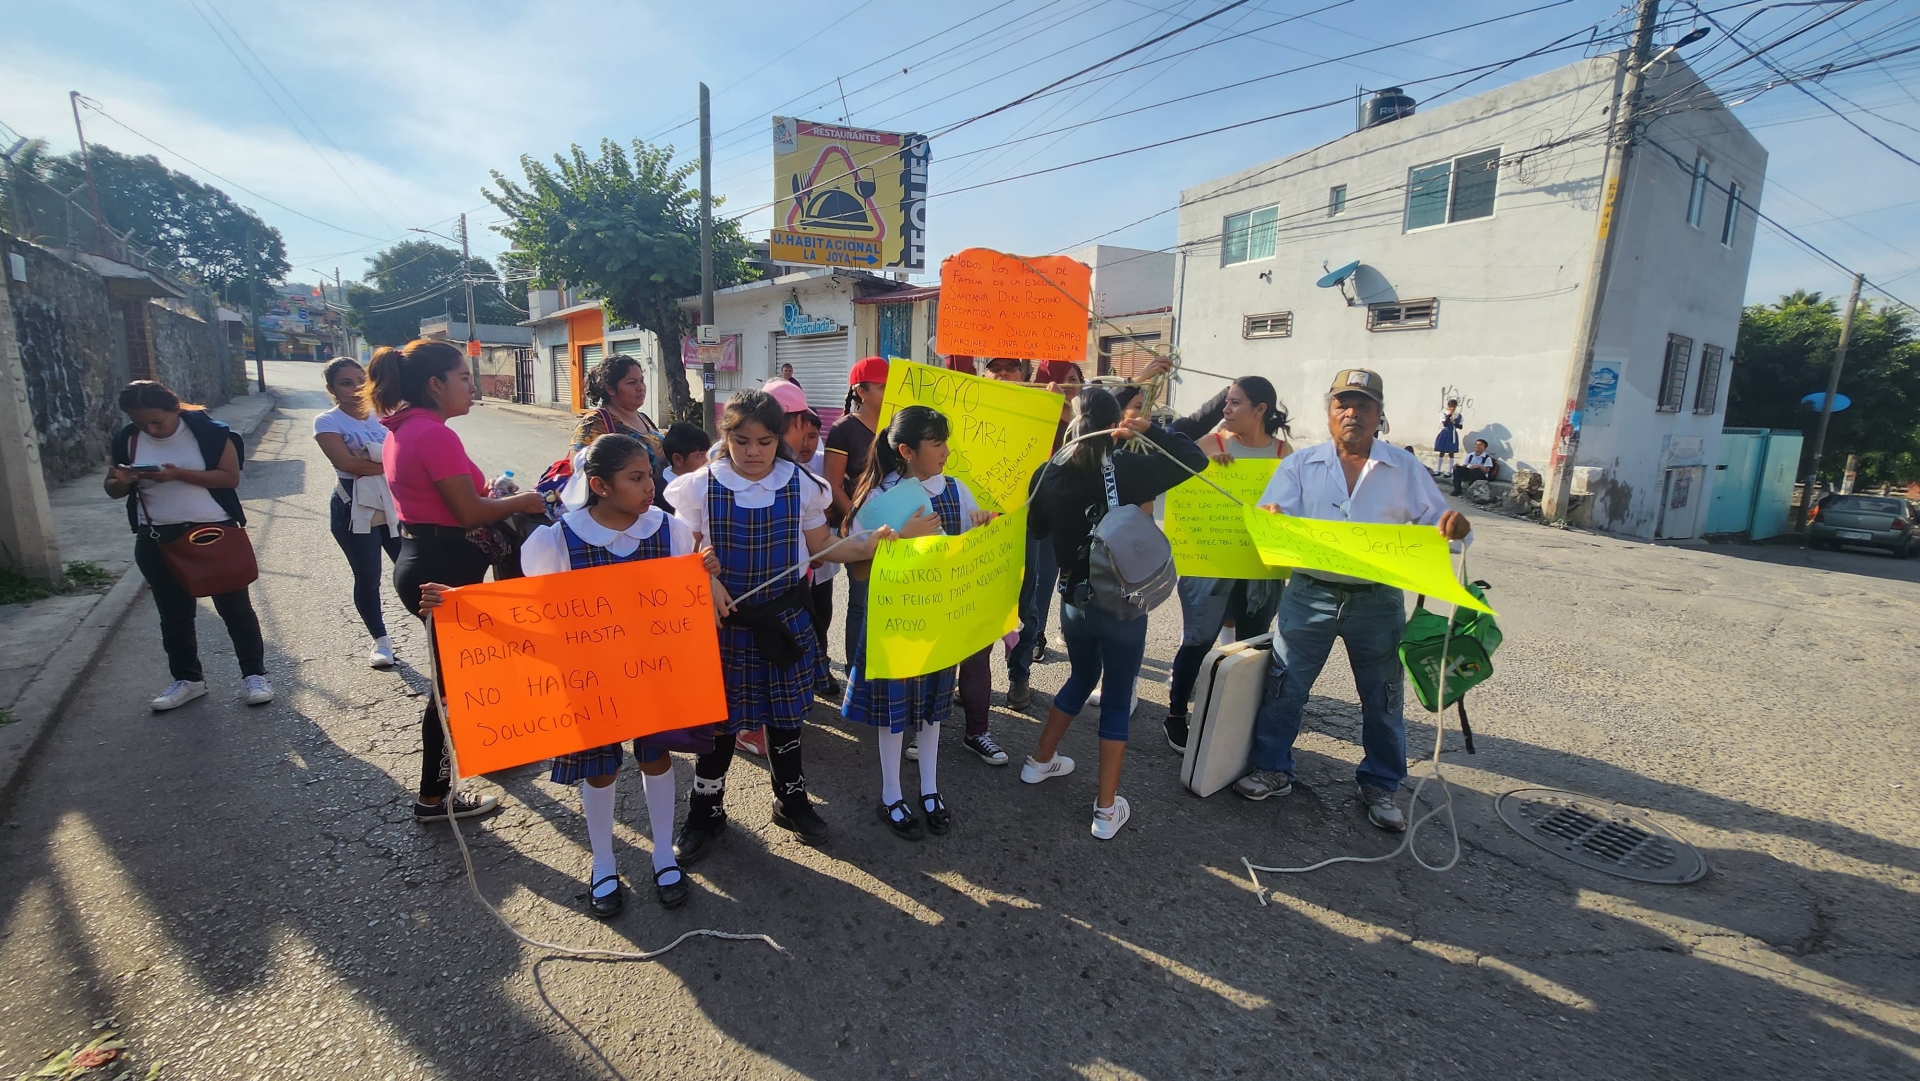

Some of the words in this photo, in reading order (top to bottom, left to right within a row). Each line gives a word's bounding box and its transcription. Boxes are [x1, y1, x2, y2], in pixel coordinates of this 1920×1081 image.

[813, 127, 881, 143] RESTAURANTES
[803, 249, 816, 261] LA
[826, 251, 850, 263] JOYA
[1056, 267, 1068, 276] DE
[948, 286, 989, 301] SANTANA
[998, 290, 1019, 303] DIAZ
[1025, 291, 1061, 305] ROMANO
[943, 304, 992, 318] APOYAMOS
[1000, 311, 1007, 319] A
[1013, 311, 1055, 320] NUESTRA
[704, 327, 713, 338] E
[942, 333, 987, 347] MARTINEZ
[998, 339, 1018, 348] PARA
[1024, 341, 1040, 350] QUE
[1044, 342, 1067, 351] SIGA
[943, 318, 994, 331] DIRECTORA
[1043, 327, 1081, 342] OCAMPO
[957, 348, 986, 356] FRENTE
[898, 367, 980, 413] APOYO
[962, 415, 1007, 451] PARA
[972, 456, 1011, 489] BASTA
[978, 486, 997, 504] DE
[997, 437, 1037, 485] DENUNCIAS
[993, 470, 1027, 508] FALSAS
[1172, 500, 1192, 509] QUE
[959, 524, 1000, 554] DIRECTORA
[1004, 517, 1012, 527] NI
[1171, 537, 1188, 547] QUE
[879, 568, 942, 585] NUESTROS
[950, 548, 994, 581] MAESTROS
[998, 541, 1013, 558] SON
[1173, 552, 1209, 561] MENTAL
[877, 594, 894, 607] UN
[948, 582, 972, 602] PARA
[455, 601, 494, 632] LA
[509, 596, 613, 625] ESCUELA
[638, 588, 668, 608] NO
[683, 584, 708, 608] SE
[885, 618, 926, 632] APOYO
[944, 600, 977, 623] TOTAL
[460, 638, 536, 669] ABRIRA
[565, 624, 626, 645] HASTA
[650, 617, 692, 636] QUE
[464, 687, 501, 710] NO
[526, 669, 600, 697] HAIGA
[623, 655, 673, 679] UNA
